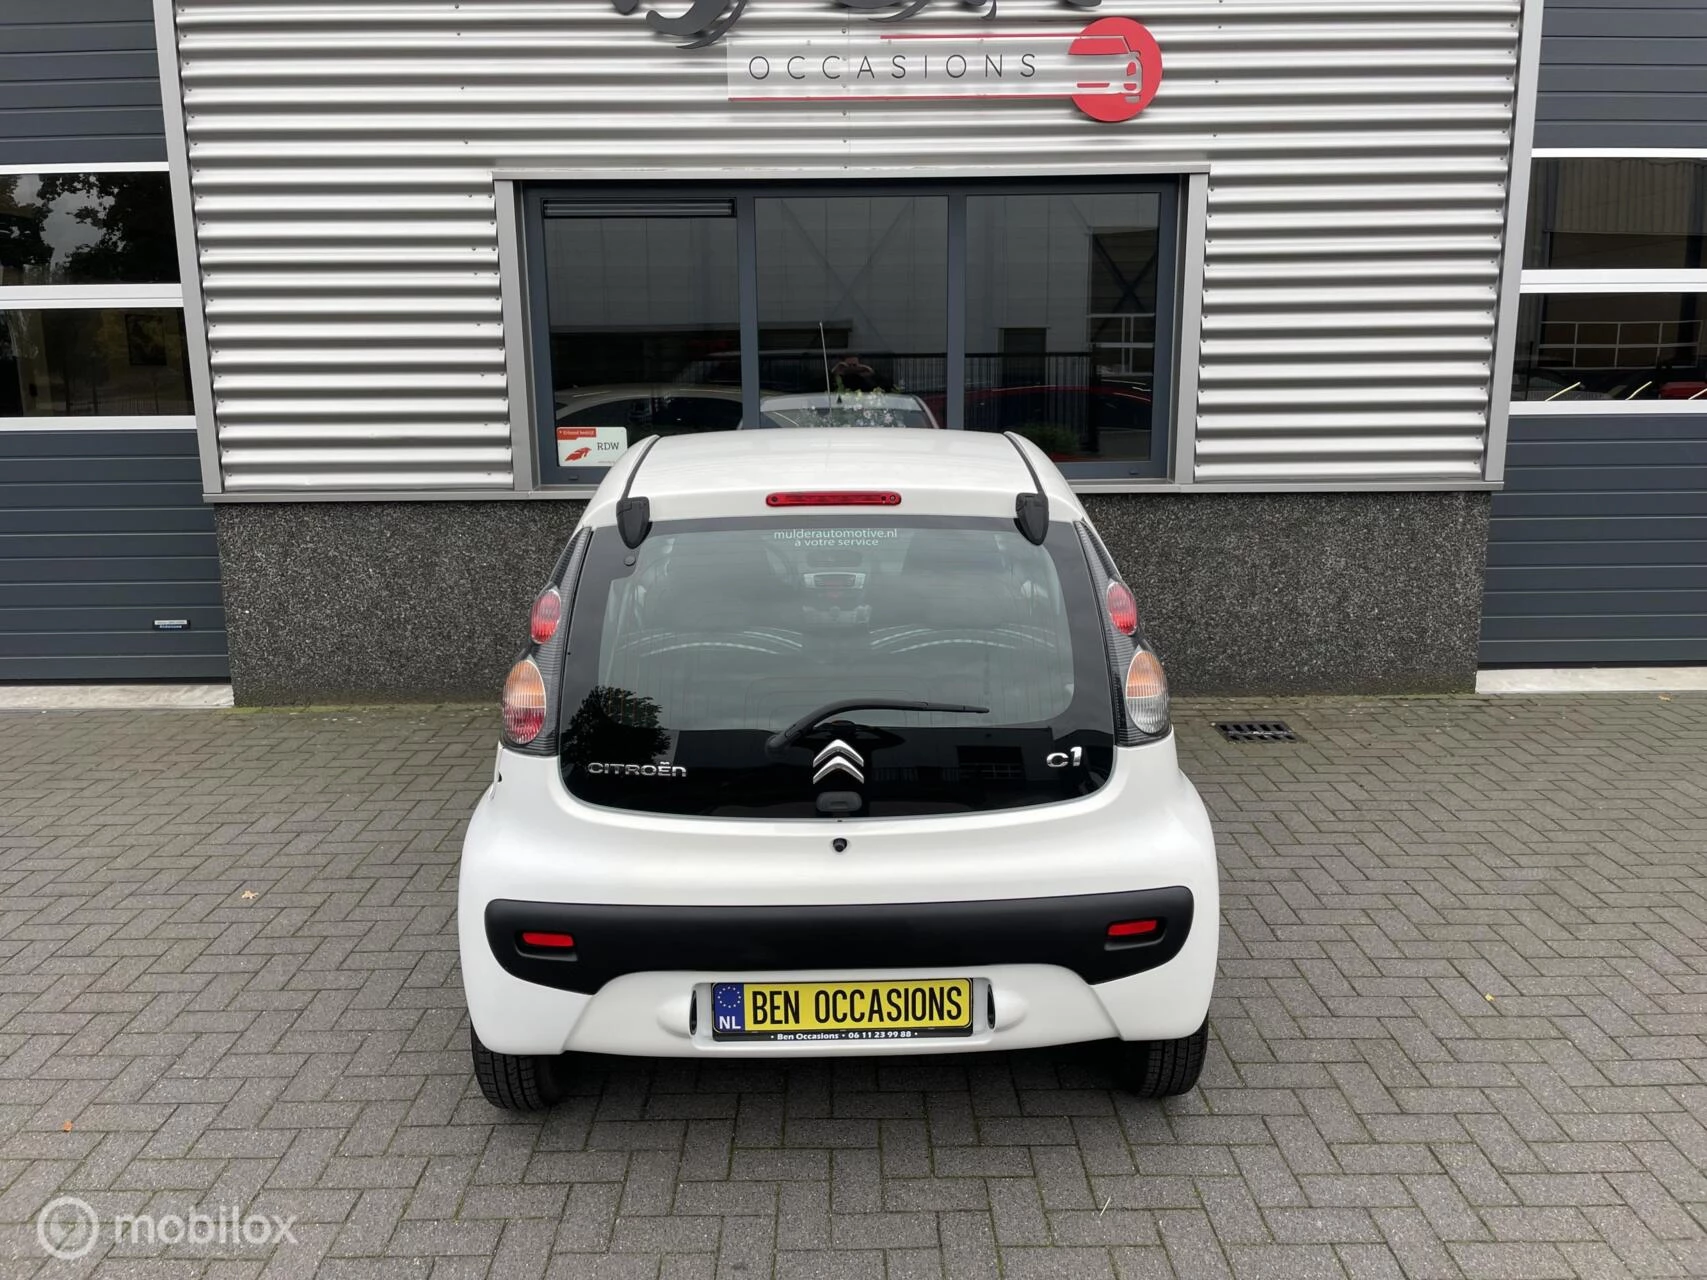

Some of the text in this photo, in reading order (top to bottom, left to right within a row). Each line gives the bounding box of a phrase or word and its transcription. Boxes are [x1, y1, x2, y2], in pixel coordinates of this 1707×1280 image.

[748, 53, 1037, 80] OCCASIONS
[597, 442, 620, 451] RDW
[773, 528, 898, 540] mulderautomotive.nl
[804, 538, 835, 547] votre
[838, 538, 879, 546] service
[752, 986, 962, 1025] BEN OCCASIONS
[719, 1016, 742, 1030] NL
[777, 1033, 795, 1041] Ben
